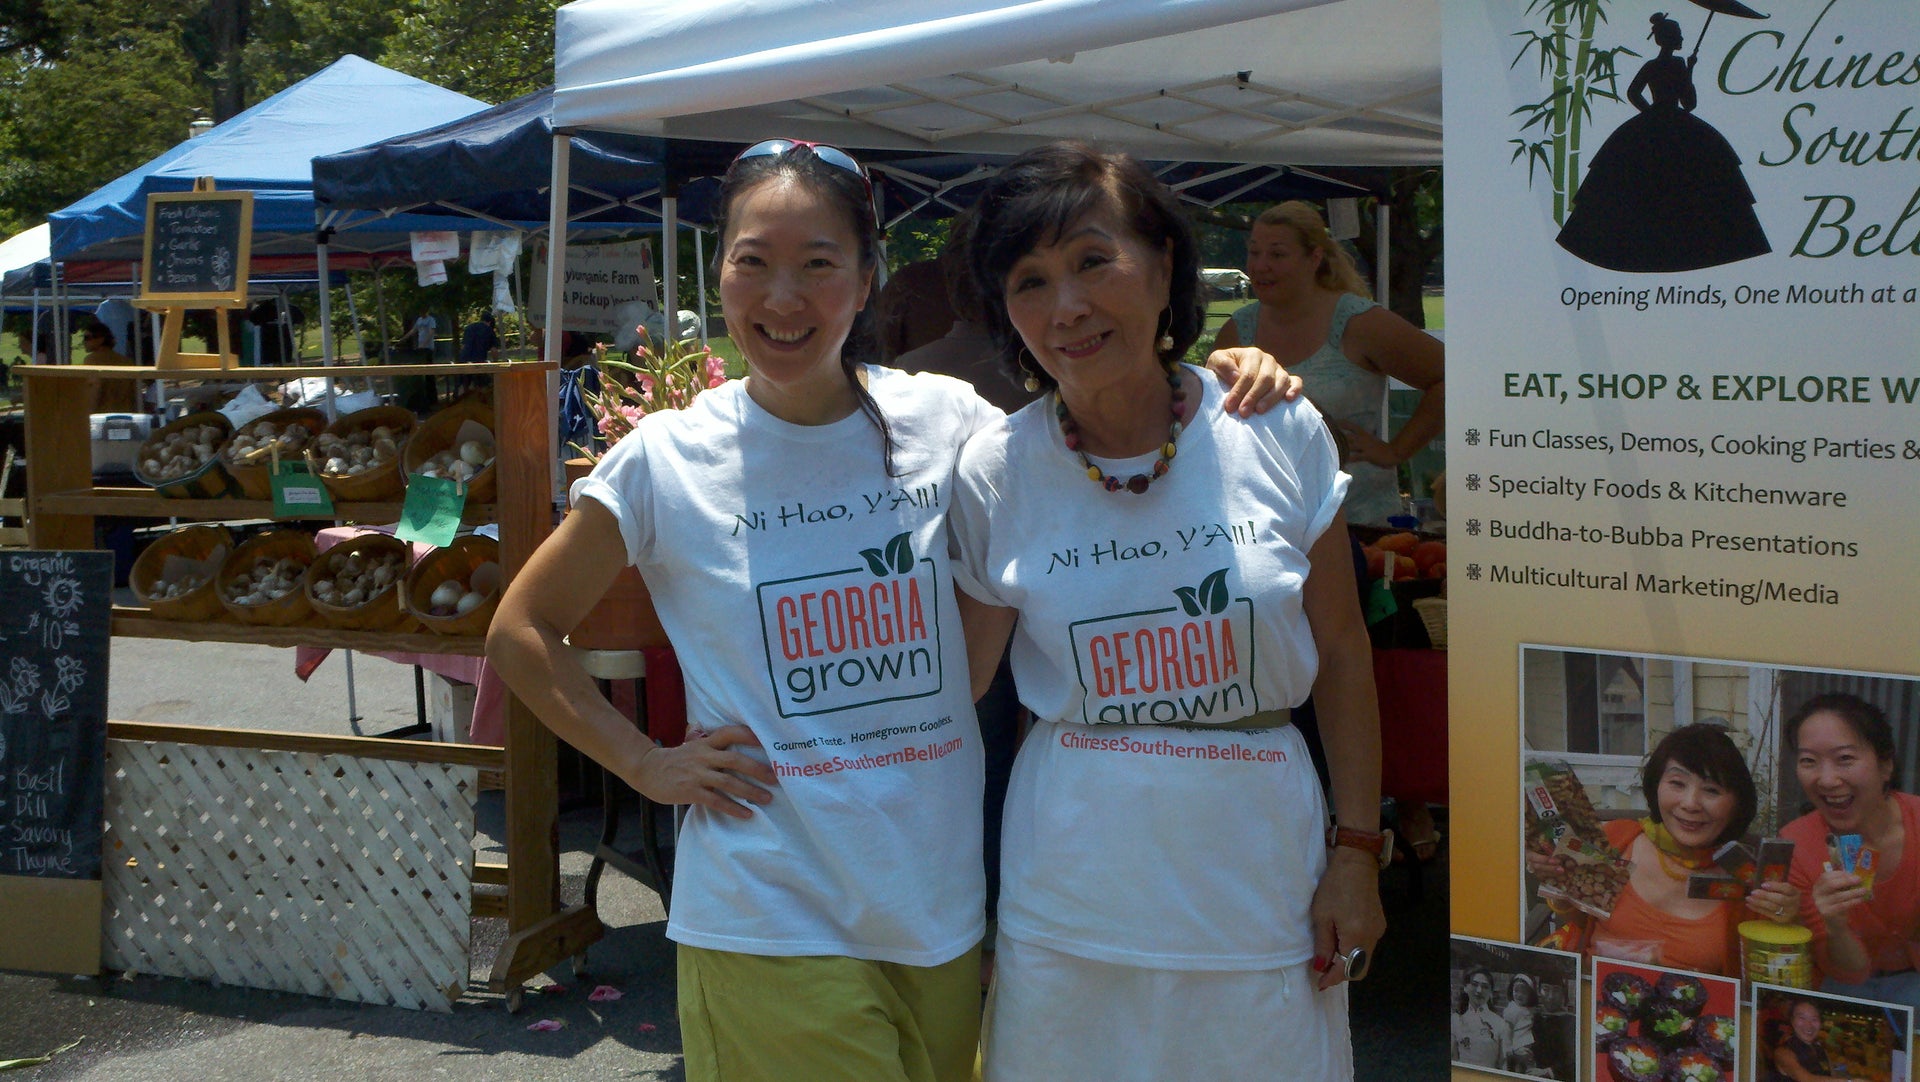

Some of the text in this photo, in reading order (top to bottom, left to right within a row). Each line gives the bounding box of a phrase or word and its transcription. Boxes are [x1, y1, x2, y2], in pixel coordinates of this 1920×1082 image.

[1789, 186, 1920, 258] Bel
[612, 270, 640, 285] Farm
[572, 292, 610, 310] Pickup
[1560, 283, 1917, 311] Opening Minds, One Mouth at a
[1504, 373, 1568, 405] EAT,
[1577, 373, 1668, 400] SHOP
[1676, 374, 1702, 400] &
[1712, 375, 1871, 403] EXPLORE
[1489, 429, 1526, 448] Fun
[1532, 429, 1614, 454] Classes,
[1621, 432, 1705, 458] Demos,
[1711, 435, 1807, 463] Cooking
[1813, 437, 1896, 459] Parties
[1489, 474, 1847, 508] Specialty Foods & Kitchenware
[731, 511, 766, 536] Ni
[778, 503, 854, 527] Hao,
[1490, 519, 1859, 558] Buddha-to-Bubba Presentations
[1047, 548, 1079, 574] Ni
[1090, 540, 1168, 565] Hao,
[1490, 564, 1839, 606] Multicultural Marketing/Media
[776, 577, 927, 662] GEORGIA
[786, 647, 931, 703] grown
[1089, 618, 1239, 698] GEORGIA
[773, 736, 817, 751] Gourmet
[819, 736, 846, 747] Taste.
[850, 725, 917, 744] Homegrown
[773, 737, 963, 778] hineseSouthernBelle.com
[16, 756, 65, 794] Basil
[16, 792, 48, 819] Dill
[11, 819, 73, 856] Savory
[9, 847, 78, 876] Thyme
